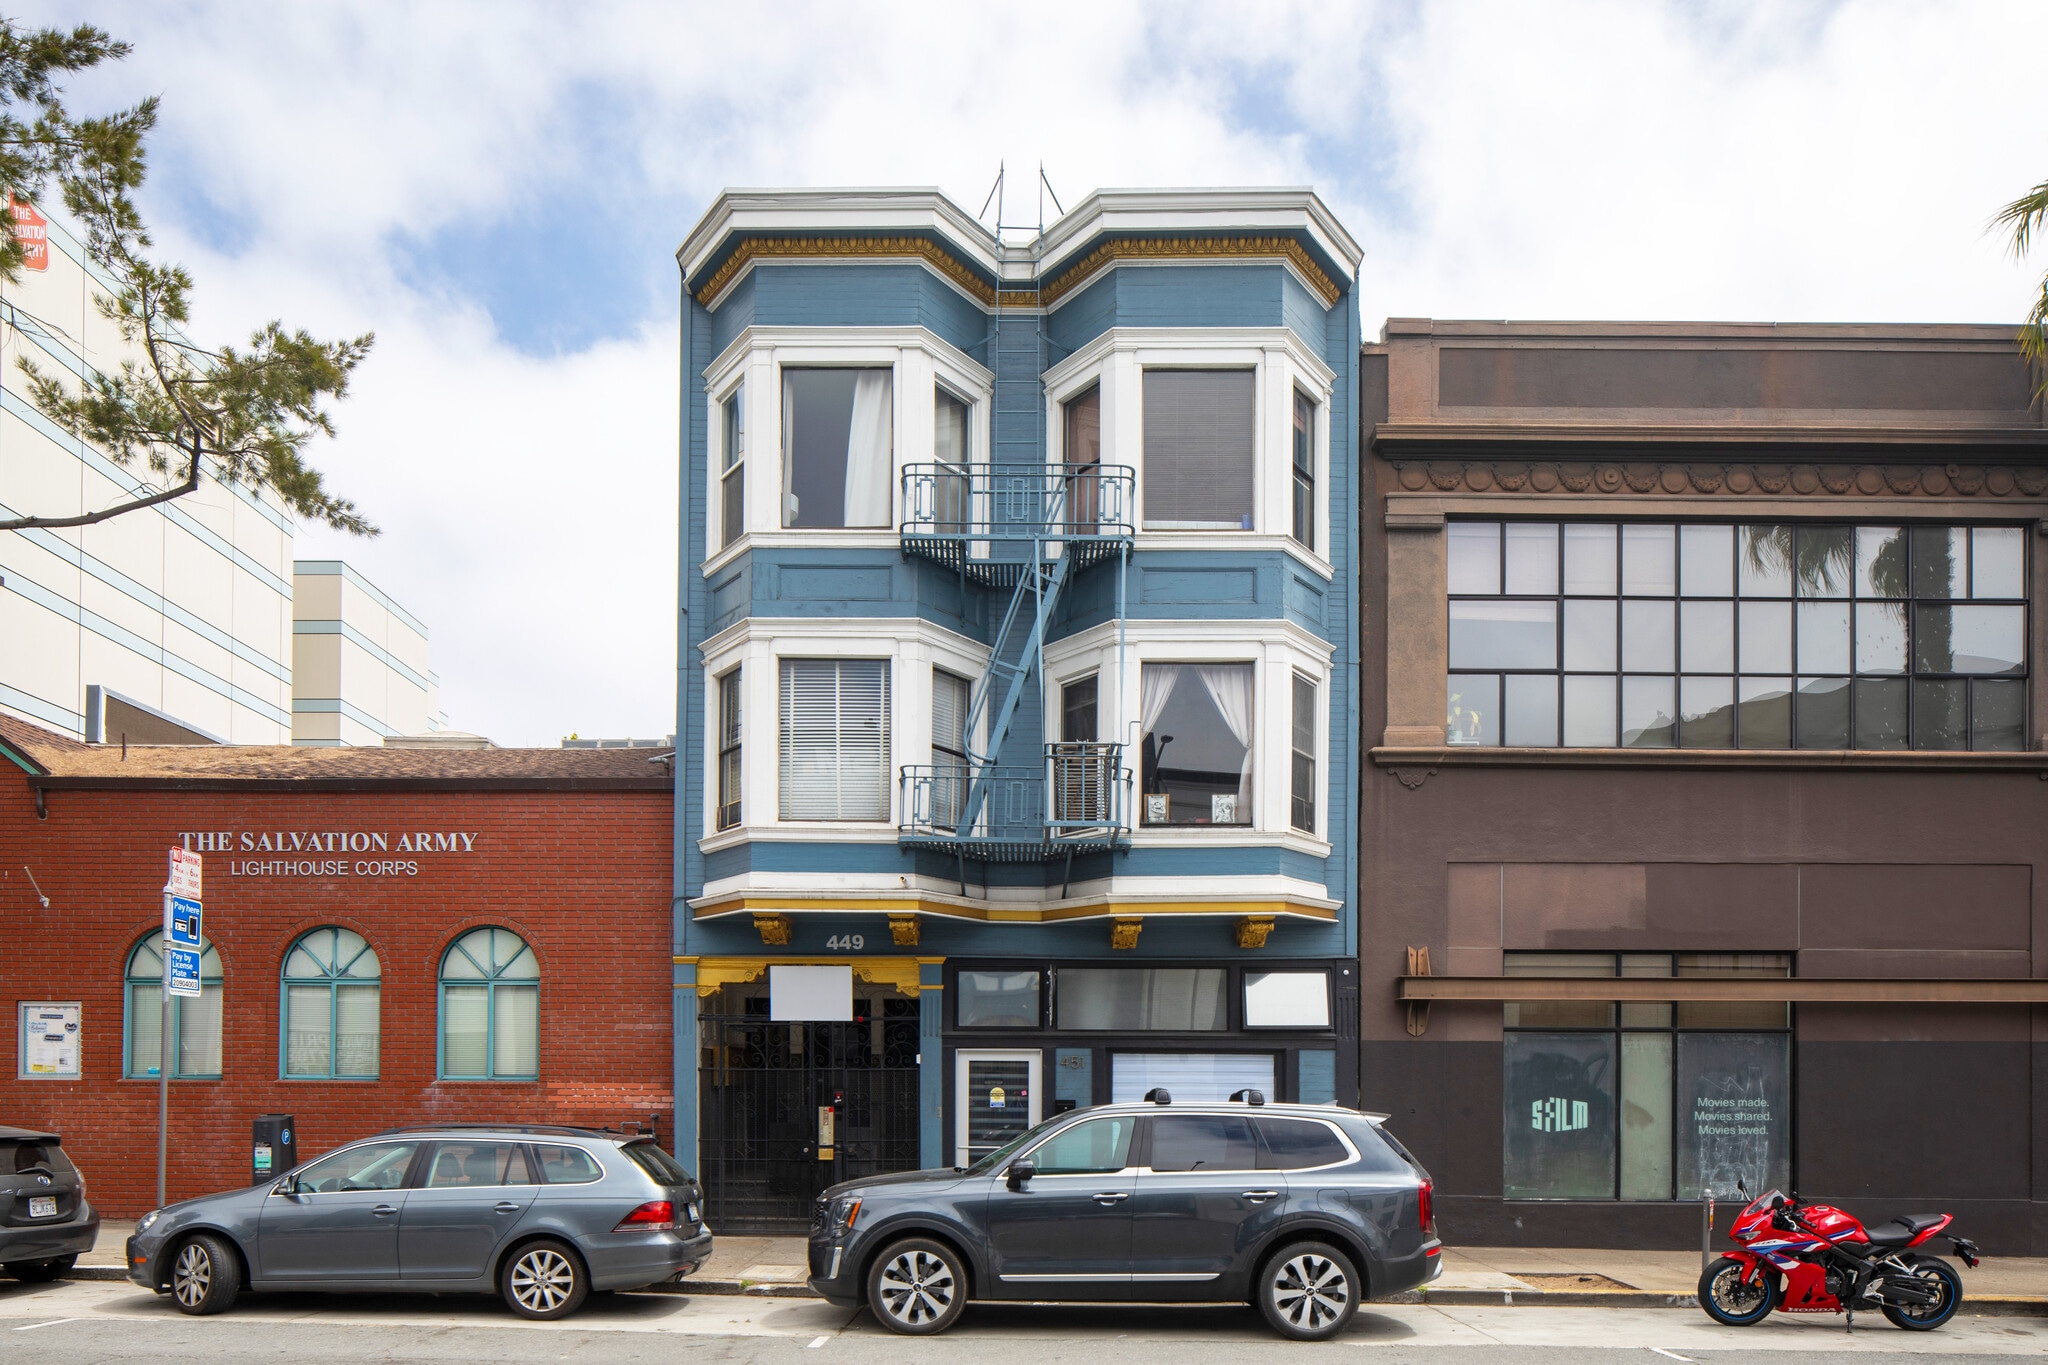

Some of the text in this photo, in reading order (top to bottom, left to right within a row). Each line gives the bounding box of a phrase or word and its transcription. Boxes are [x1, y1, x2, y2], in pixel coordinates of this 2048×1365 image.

[13, 205, 32, 220] THE
[9, 223, 46, 241] ALVATION
[178, 831, 479, 853] THE SALVATION ARMY
[173, 848, 201, 868] NO PARKING
[230, 860, 419, 876] LIGHTHOUSE CORPS
[174, 901, 200, 915] Pay here
[826, 934, 865, 950] 449
[172, 951, 192, 963] Pay by
[172, 960, 194, 971] License
[172, 968, 187, 978] Plate
[172, 978, 198, 989] 20904003
[1060, 1055, 1086, 1069] 451
[1697, 1097, 1770, 1107] Movies made.
[1694, 1111, 1773, 1121] Movies shared.
[1698, 1125, 1769, 1135] Movies loved.
